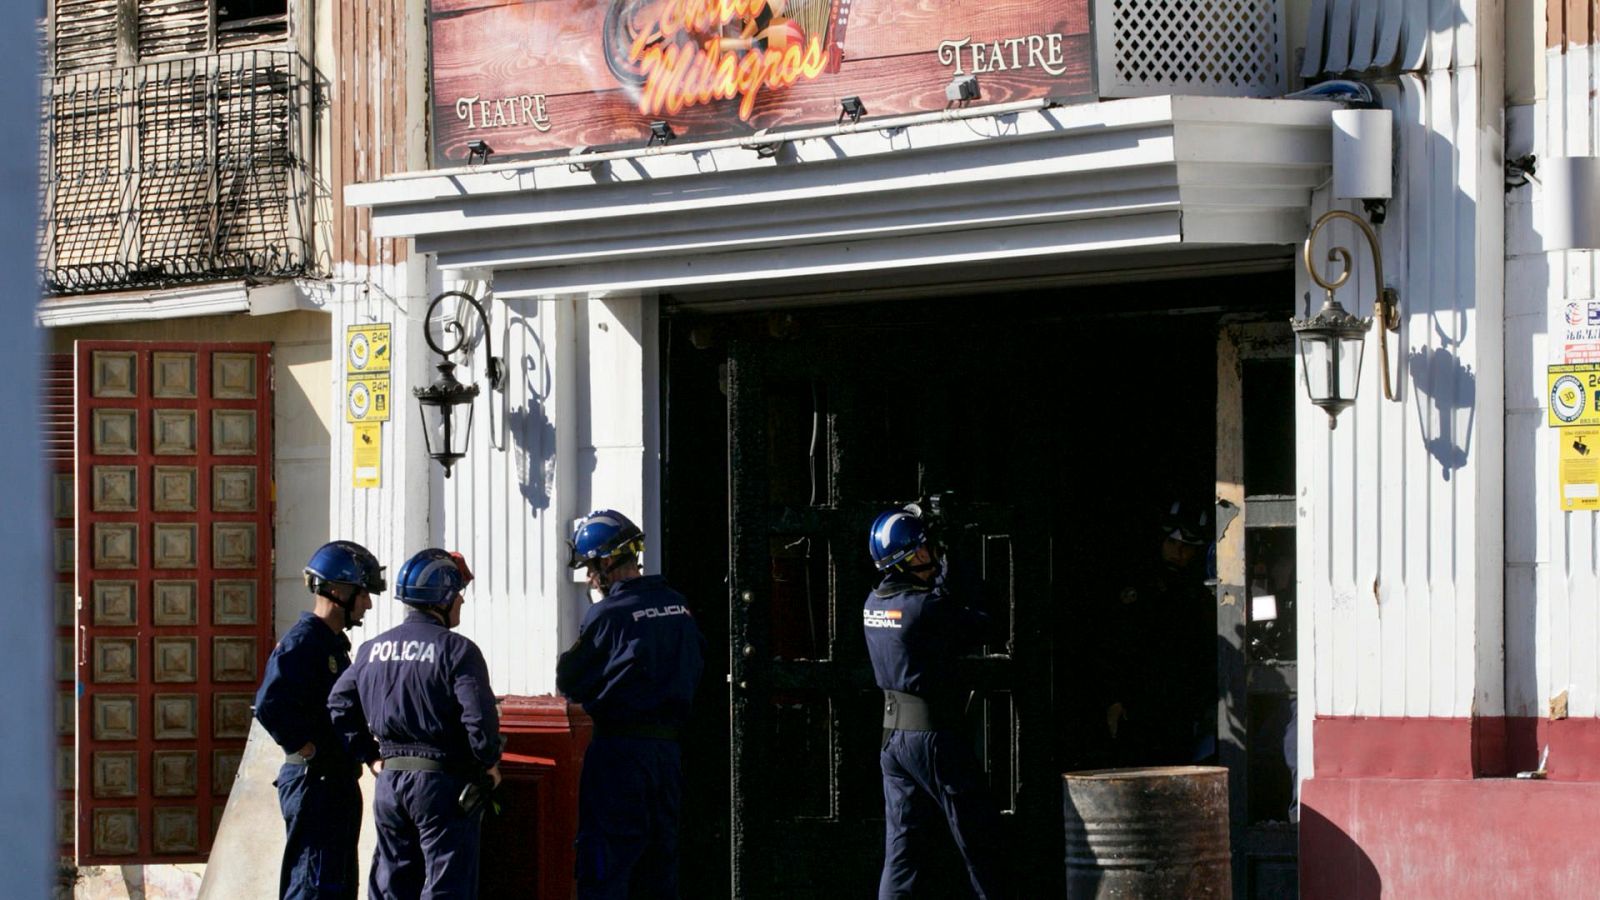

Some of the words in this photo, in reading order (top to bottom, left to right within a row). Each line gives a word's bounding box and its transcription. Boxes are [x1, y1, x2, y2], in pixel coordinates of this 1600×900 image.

[638, 33, 829, 121] Milagros
[372, 332, 388, 343] 24H
[372, 382, 388, 393] 24H
[1588, 374, 1600, 388] 2
[631, 604, 691, 622] POLICIA
[369, 640, 435, 664] POLICIA
